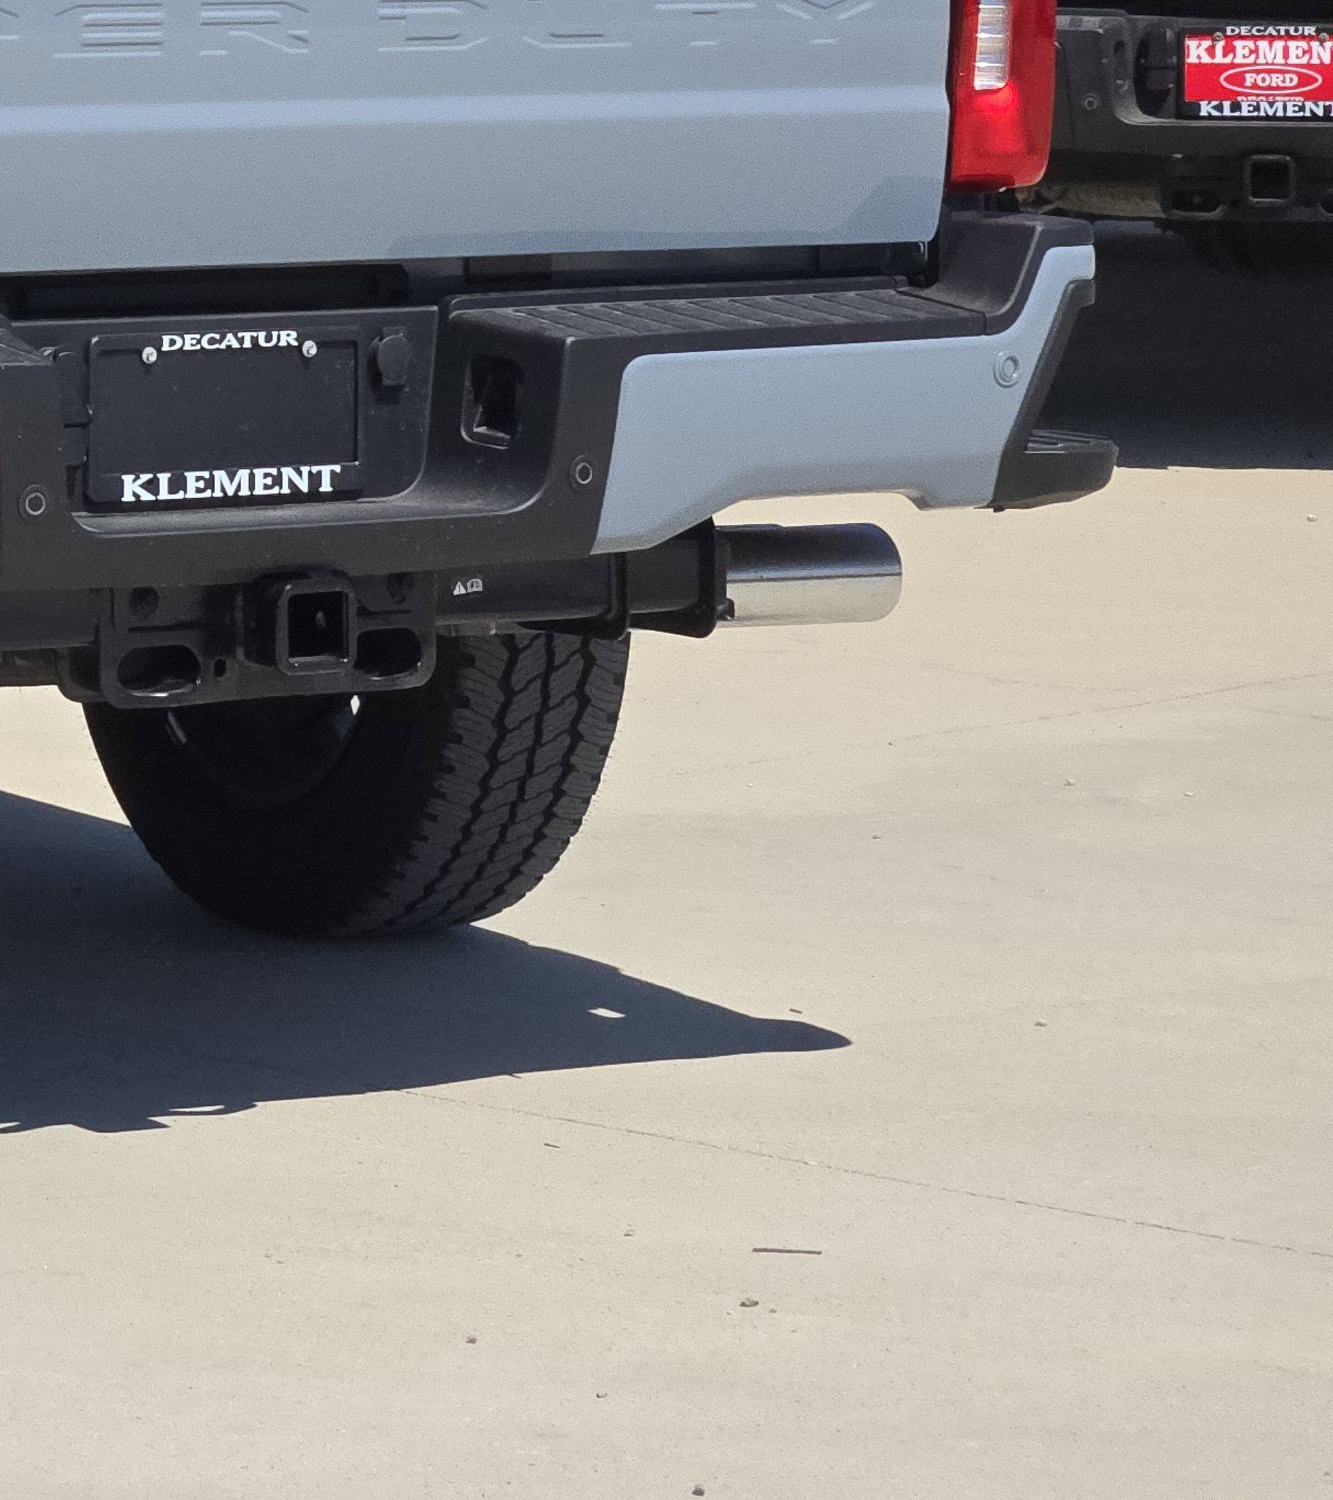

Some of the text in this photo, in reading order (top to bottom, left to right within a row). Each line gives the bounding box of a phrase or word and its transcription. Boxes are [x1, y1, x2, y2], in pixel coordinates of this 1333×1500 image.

[1225, 25, 1317, 36] DECATUR
[1185, 40, 1333, 65] KLEMEN
[1244, 72, 1299, 87] FORD
[161, 329, 299, 352] DECATUR
[120, 464, 341, 502] KLEMENT
